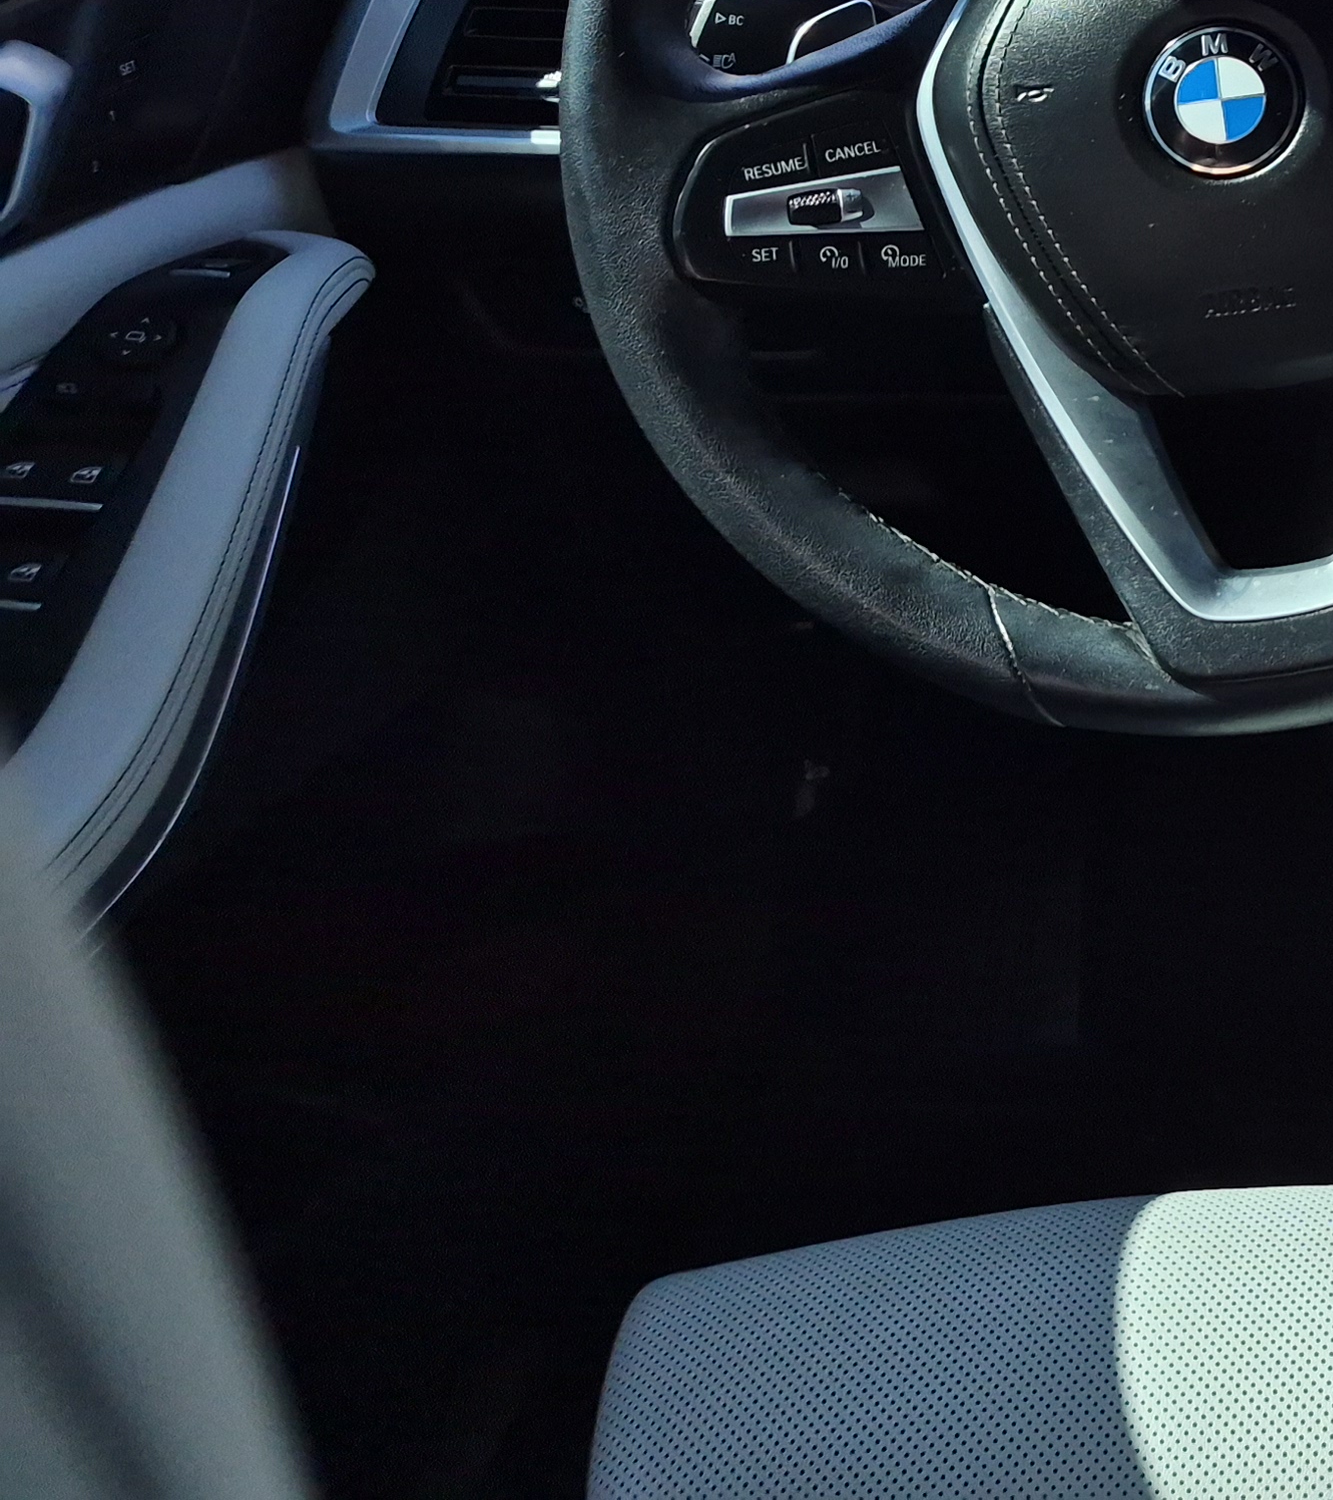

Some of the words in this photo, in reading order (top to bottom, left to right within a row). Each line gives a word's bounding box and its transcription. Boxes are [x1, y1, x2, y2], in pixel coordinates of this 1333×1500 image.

[728, 14, 745, 26] BC
[1160, 32, 1278, 84] BMW
[119, 59, 136, 76] SET
[824, 139, 882, 164] CANCEL
[744, 157, 805, 182] RESUME
[751, 247, 779, 263] SET
[887, 252, 927, 269] MODE
